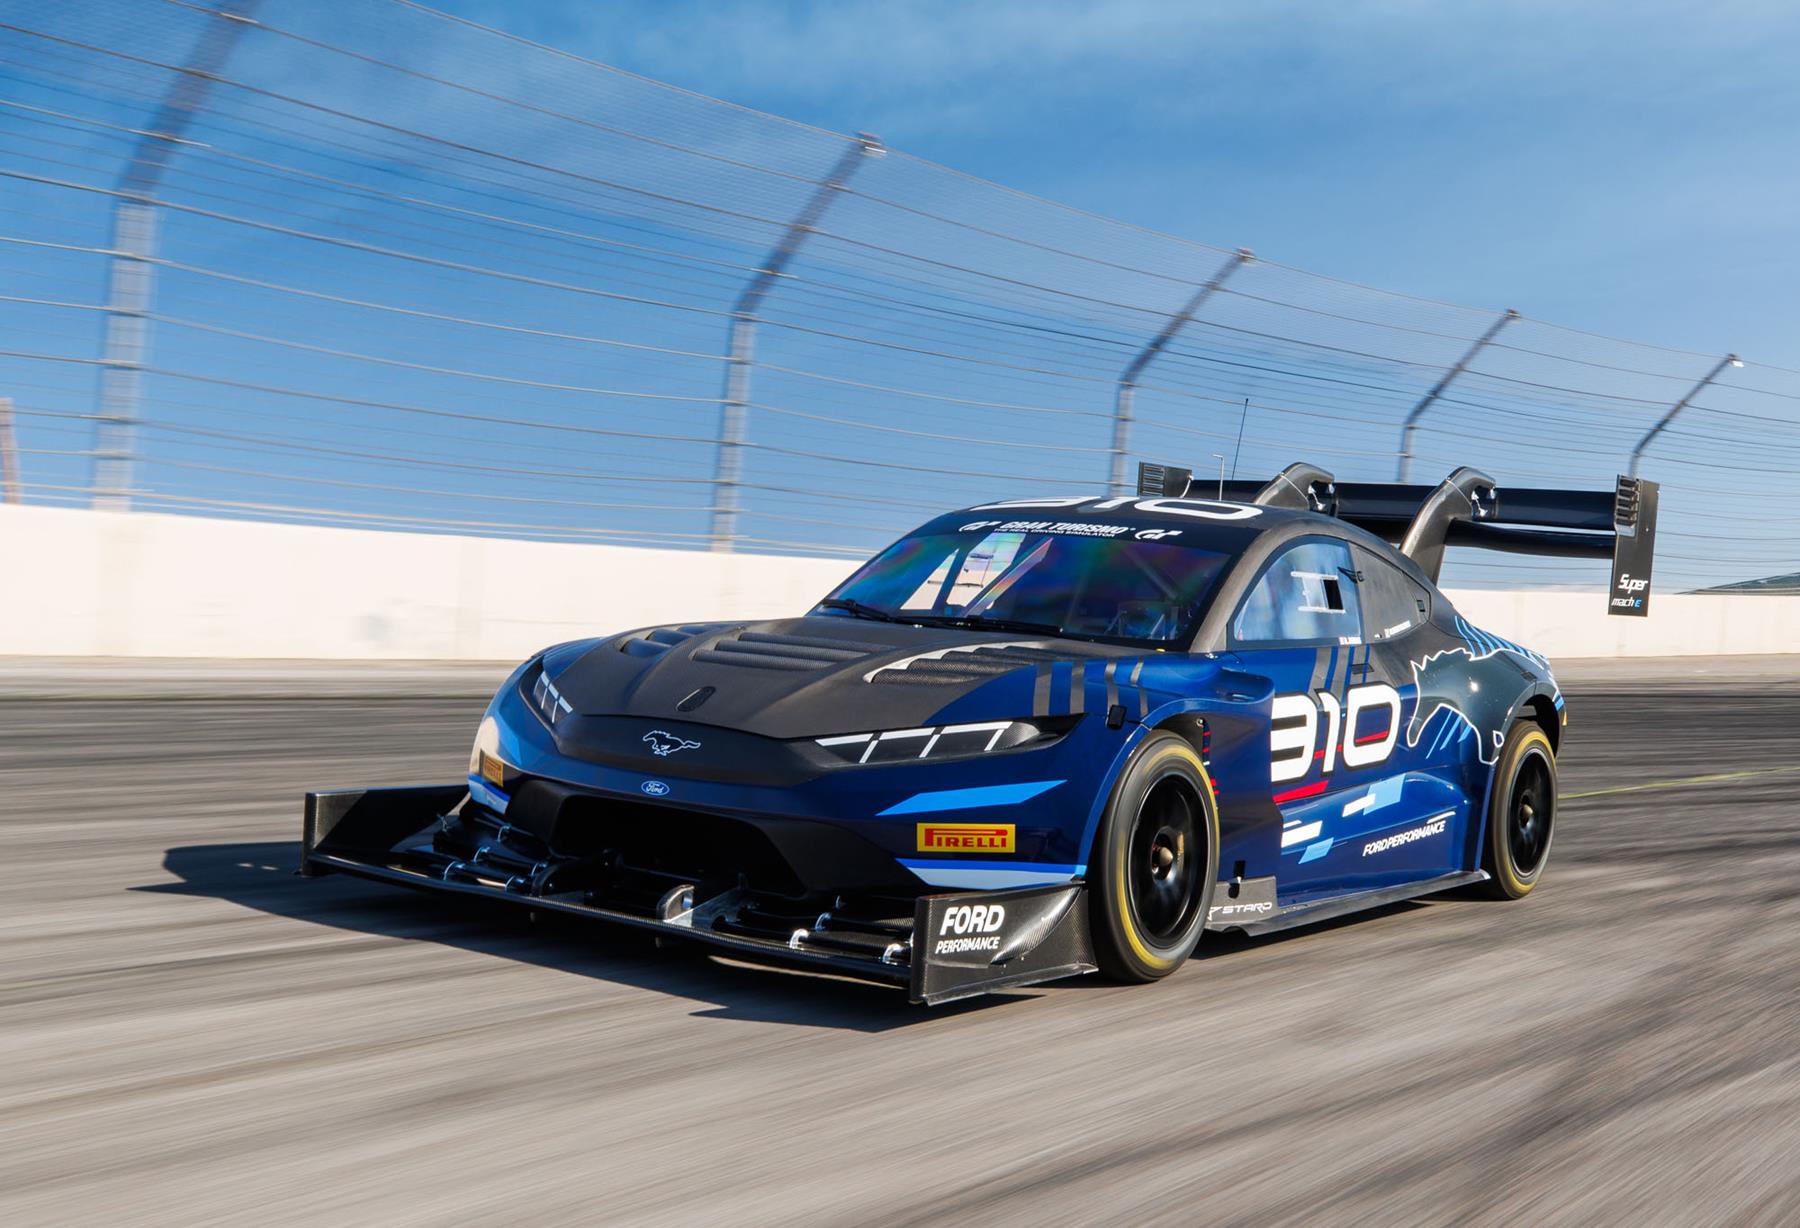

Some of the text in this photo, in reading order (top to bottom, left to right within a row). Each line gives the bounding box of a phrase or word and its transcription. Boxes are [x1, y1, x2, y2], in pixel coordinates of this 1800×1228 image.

[1000, 521, 1129, 534] GRAN TURISMO
[1618, 573, 1649, 594] Super
[1270, 684, 1402, 782] 310
[924, 828, 1009, 848] PIRELLI
[940, 904, 1005, 935] FORD
[935, 936, 1001, 954] PERFORMANCE
